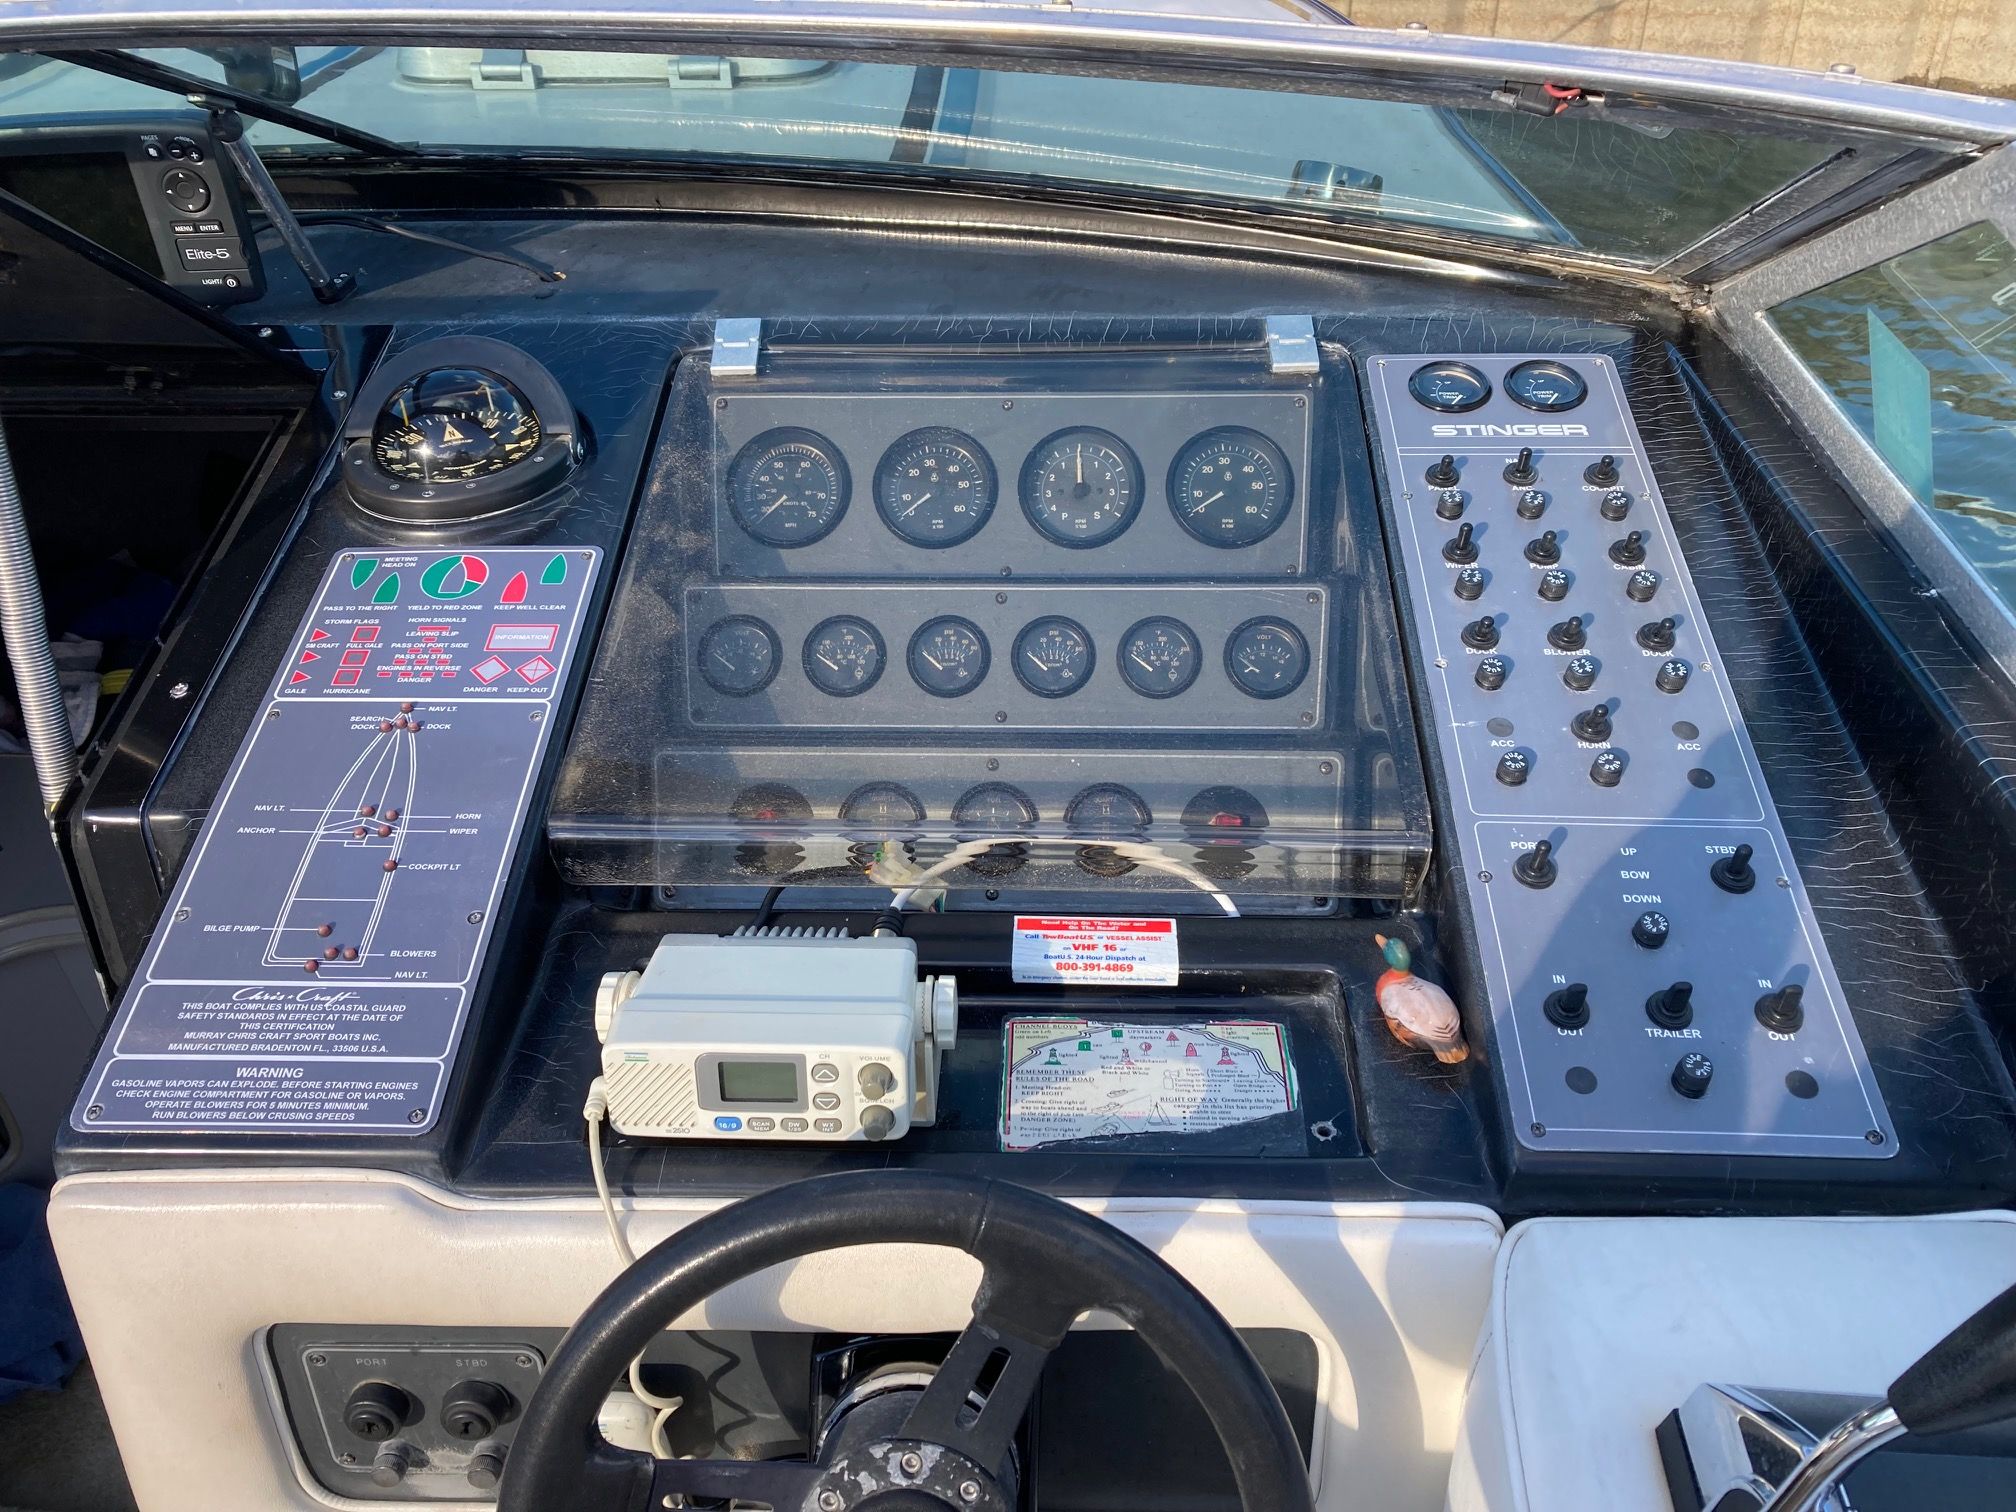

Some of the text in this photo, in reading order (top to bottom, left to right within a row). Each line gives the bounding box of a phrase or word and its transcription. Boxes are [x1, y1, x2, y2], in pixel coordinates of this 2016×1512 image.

[185, 248, 230, 260] Elite-5
[483, 418, 499, 429] 30
[1431, 424, 1590, 436] STINGER
[800, 460, 811, 468] 60
[924, 459, 936, 467] 30
[1218, 457, 1230, 465] 30
[1202, 466, 1213, 474] 20
[1251, 482, 1263, 490] 50
[807, 510, 817, 518] 75
[1245, 506, 1257, 514] 60
[1490, 740, 1515, 748] ACC
[1577, 741, 1611, 749] HORN
[1677, 743, 1701, 751] ACC
[1620, 847, 1637, 856] UP
[1704, 845, 1737, 854] STBD
[1620, 870, 1650, 880] BOW
[1622, 894, 1662, 904] DOWN
[1072, 943, 1117, 952] VHF 16
[390, 950, 437, 958] BLOWERS
[1056, 962, 1134, 972] 800-391-4869
[394, 971, 413, 979] NAV
[1552, 974, 1566, 984] IN
[1758, 979, 1772, 988] IN
[182, 1002, 203, 1010] THIS
[205, 1002, 232, 1010] BOAT
[233, 1003, 282, 1011] COMPLIES
[325, 1004, 370, 1012] COASTAL
[371, 1004, 406, 1012] GUARD
[177, 1012, 215, 1020] SAFETY
[216, 1012, 275, 1020] STANDARDS
[277, 1013, 288, 1021] IN
[342, 1014, 360, 1022] THE
[362, 1014, 387, 1022] DATE
[389, 1014, 404, 1022] OF
[239, 1022, 335, 1031] THIS CERTIFICATION
[183, 1032, 224, 1040] MURRAY
[227, 1032, 257, 1040] CHRIS
[258, 1032, 291, 1040] CRAFT
[292, 1033, 326, 1041] SPORT
[1557, 1028, 1584, 1036] OUT
[1644, 1028, 1702, 1039] TRAILER
[1768, 1032, 1796, 1042] OUT
[167, 1043, 249, 1051] MANUFACTURED
[250, 1044, 311, 1052] BRADENTON
[361, 1045, 388, 1053] U.S.A.
[236, 1067, 304, 1078] WARNING
[111, 1080, 419, 1090] GASOLINE VAPORS CAN EXPLODE. BEFORE STARTING ENGINES
[116, 1090, 406, 1101] CHECK ENGINE COMPARTMENT FOR GASOLINE OR VAPORS.
[144, 1100, 370, 1110] OPERATE BLOWERS FOR 5 MINUTES MINIMUM.
[151, 1111, 355, 1121] RUN BLOWERS BELOW CRUSING SPEEDS
[356, 1358, 388, 1366] PORT
[455, 1359, 488, 1367] STBD
